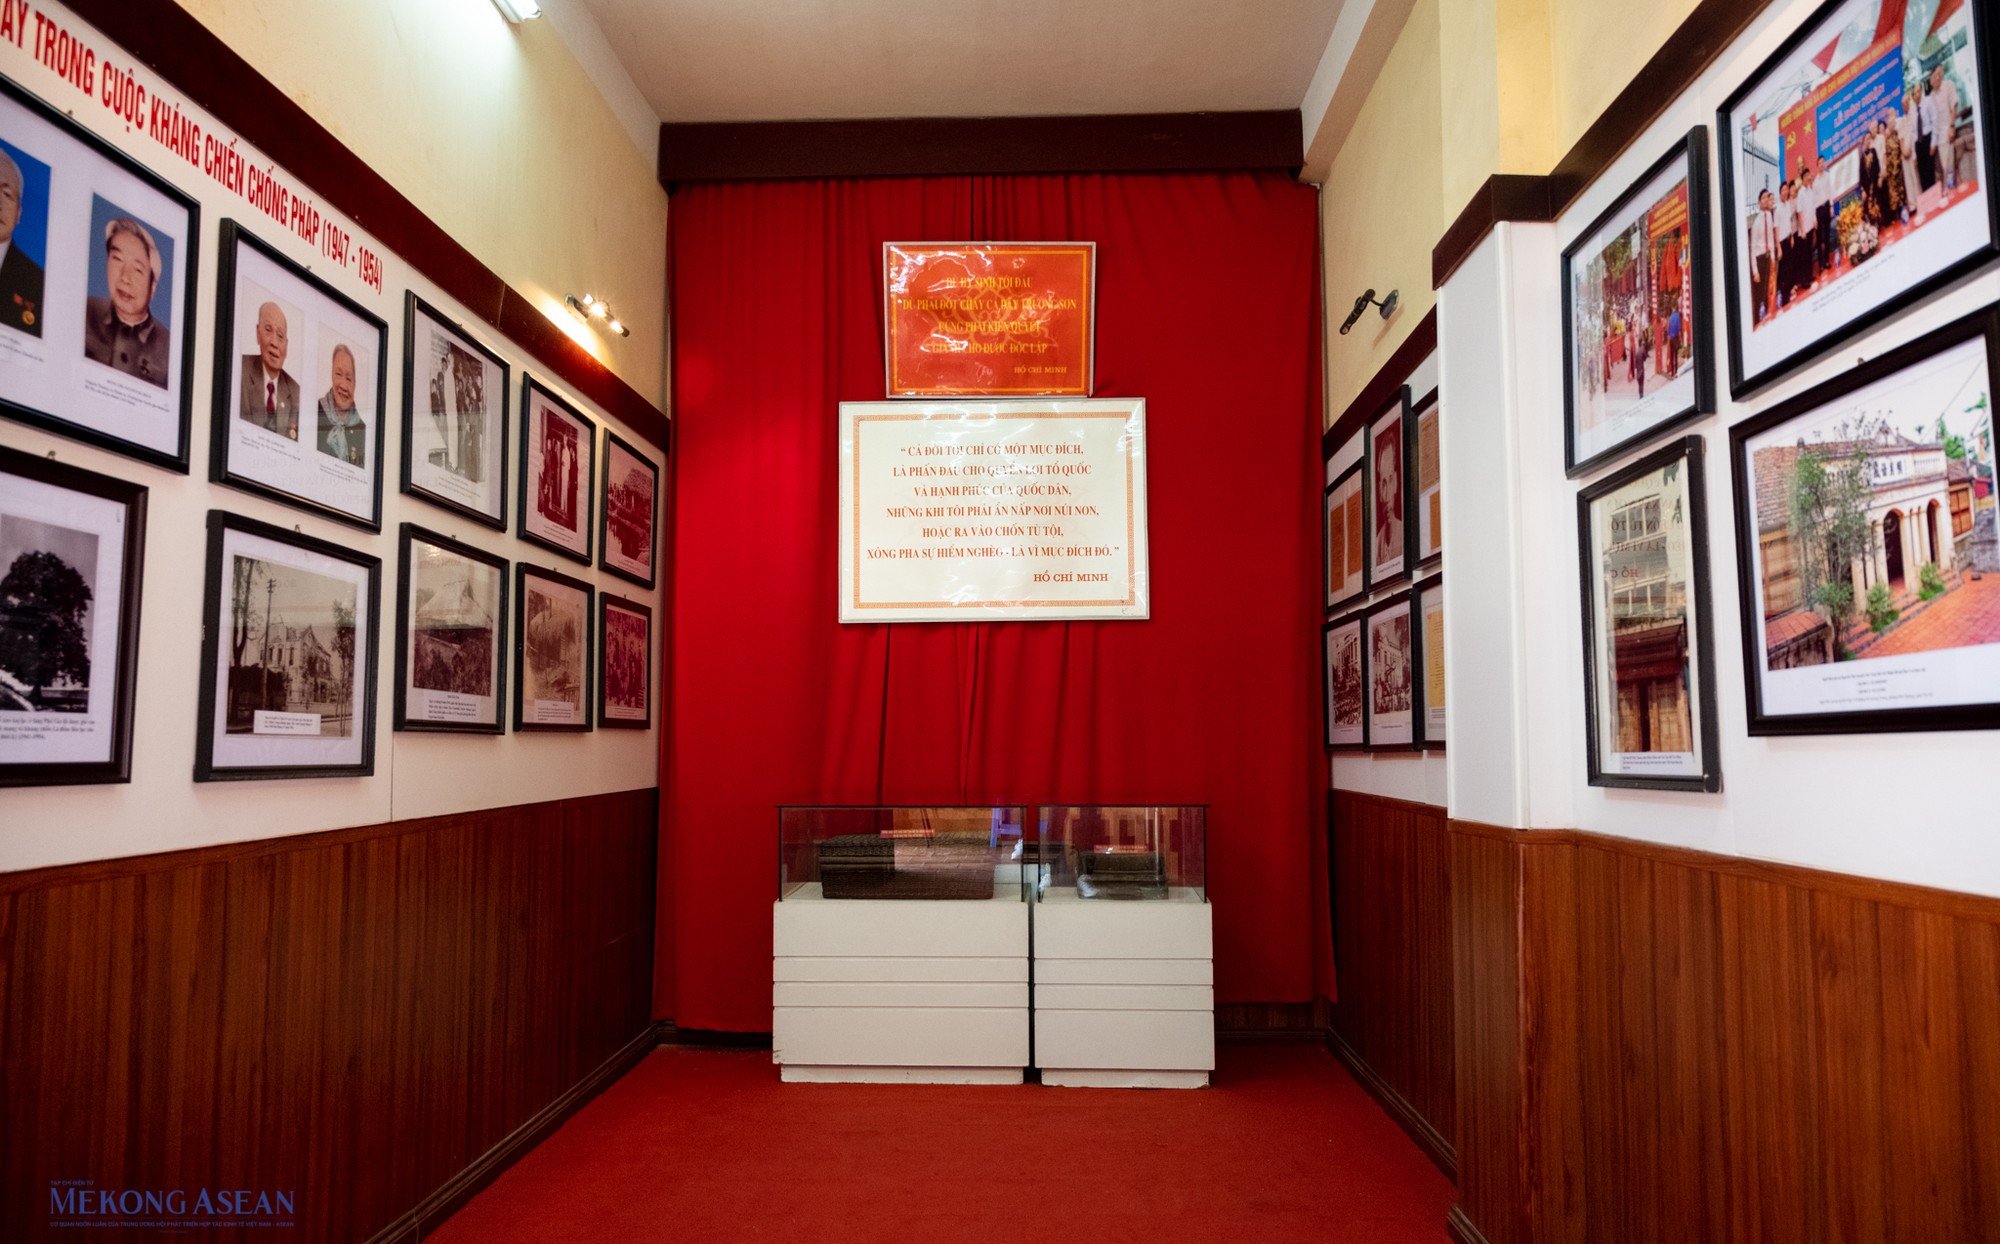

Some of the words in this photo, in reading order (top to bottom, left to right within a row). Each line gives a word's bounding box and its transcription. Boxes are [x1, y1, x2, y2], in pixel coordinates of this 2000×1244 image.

[35, 10, 96, 98] TRONG
[101, 61, 145, 132] CUỘC
[149, 93, 201, 169] KHÁNG
[204, 134, 245, 198] CHIẾN
[248, 164, 288, 222] CHỐNG
[290, 195, 320, 247] PHÁP
[321, 217, 351, 269] (1947
[358, 245, 384, 296] 1954)
[974, 276, 995, 288] SINH
[1015, 276, 1032, 288] ĐÂU
[1028, 364, 1042, 374] CHÍ
[1044, 364, 1067, 374] MINH
[908, 444, 922, 456] CẢ
[925, 444, 943, 456] ĐỜI
[966, 442, 984, 455] CHỈ
[1004, 442, 1027, 456] MỘT
[1030, 444, 1053, 456] MỤC
[1055, 442, 1084, 455] ĐÍCH,
[893, 465, 906, 477] LÀ
[909, 463, 937, 477] PHẤN
[963, 465, 985, 476] CHO
[1045, 460, 1060, 475] TỔ
[1062, 461, 1092, 477] QUỐC
[914, 484, 927, 496] VÀ
[930, 486, 959, 499] HẠNH
[962, 483, 990, 496] PHÚC
[1016, 482, 1045, 497] QUỐC
[1048, 483, 1072, 496] DÂN,
[886, 505, 923, 518] NHỮNG
[925, 506, 944, 517] KHI
[947, 504, 964, 517] TÔI
[967, 503, 991, 516] PHẢI
[1011, 502, 1031, 516] NẤP
[1033, 505, 1052, 516] NƠI
[1054, 503, 1072, 516] NÚI
[1075, 505, 1100, 517] NON,
[922, 526, 951, 540] HOẶC
[954, 527, 968, 537] RA
[970, 524, 993, 537] VÀO
[995, 522, 1025, 537] CHỐN
[1027, 523, 1041, 536] TÙ
[867, 547, 896, 559] XÔNG
[899, 548, 919, 559] PHA
[921, 547, 936, 561] SỰ
[937, 544, 964, 558] HIỂM
[1011, 544, 1025, 557] LÀ
[1028, 544, 1038, 557] VÌ
[1041, 546, 1065, 559] MỤC
[1066, 544, 1092, 557] ĐÍCH
[1033, 570, 1050, 582] HỒ
[1053, 571, 1073, 582] CHÍ
[1077, 573, 1109, 582] MINH
